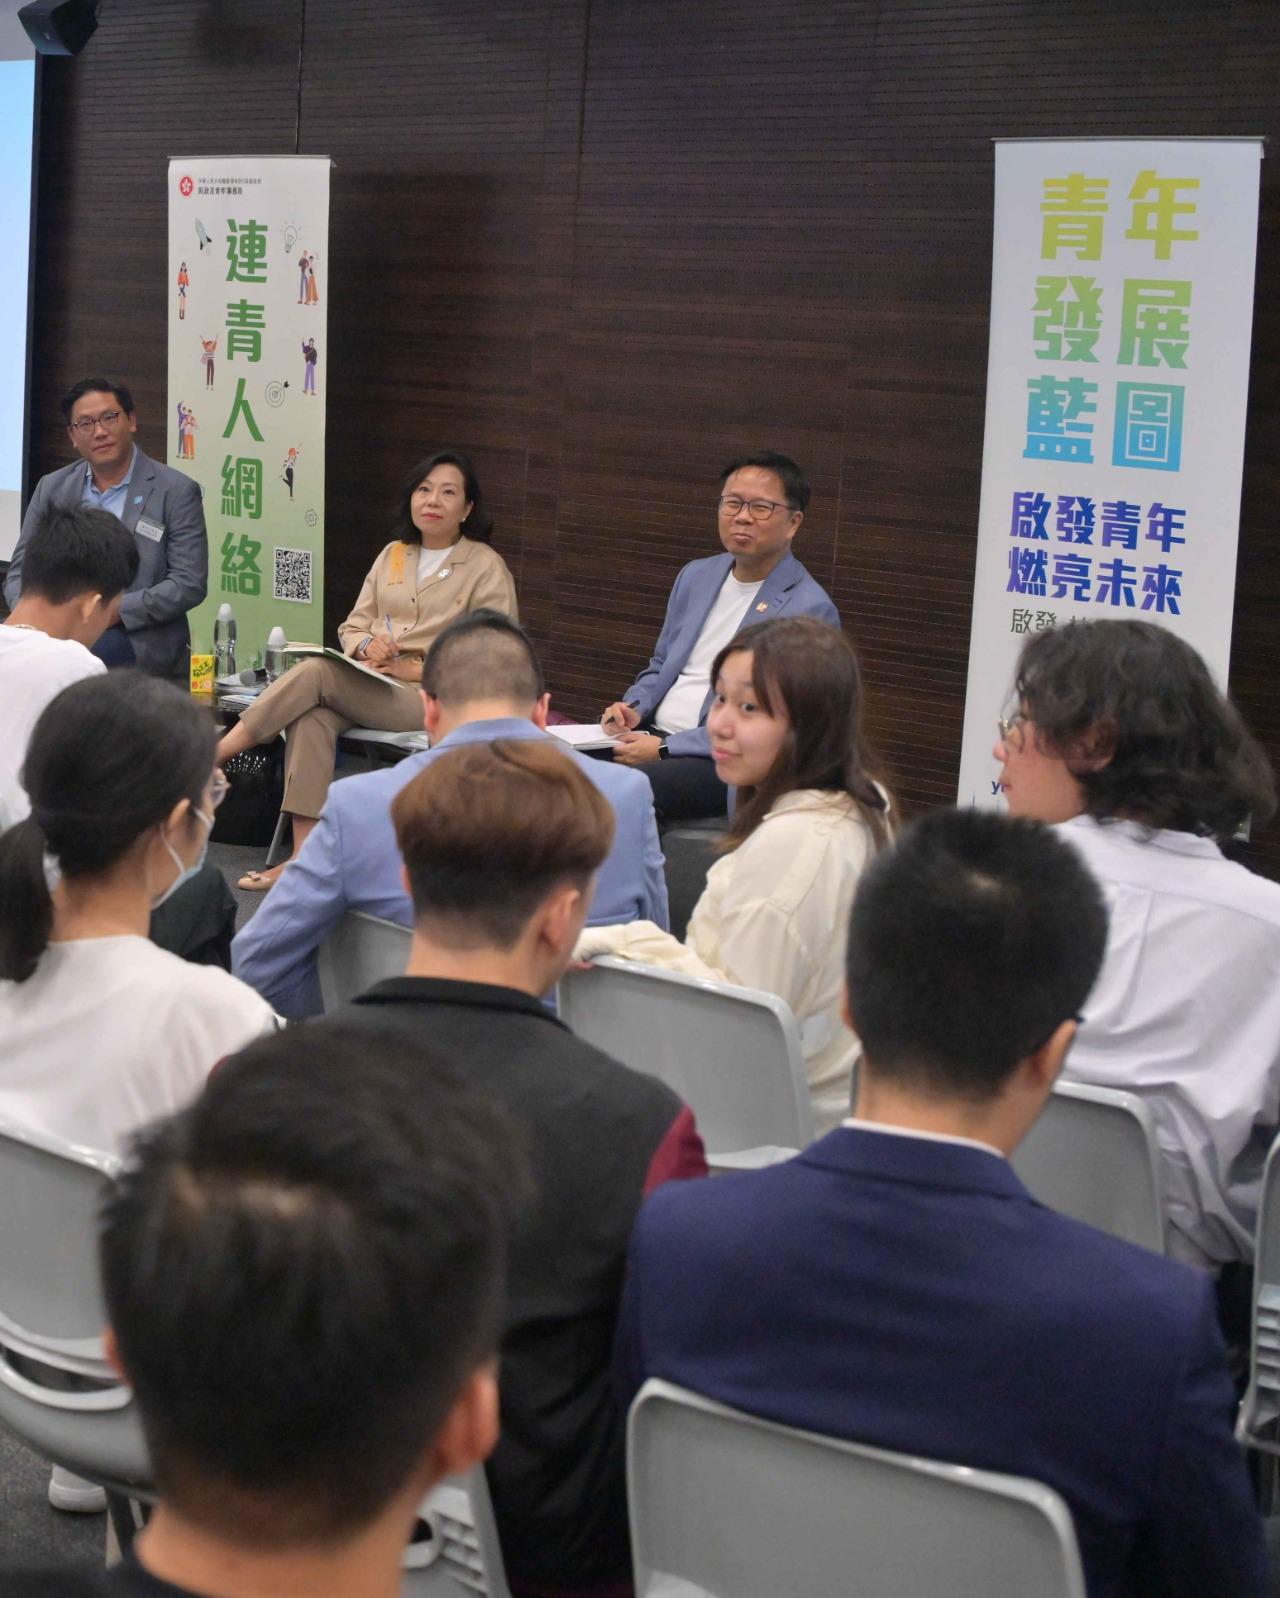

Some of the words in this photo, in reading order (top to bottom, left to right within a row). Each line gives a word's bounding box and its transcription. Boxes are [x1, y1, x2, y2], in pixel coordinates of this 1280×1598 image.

[1040, 169, 1200, 261] 青年
[1031, 275, 1192, 369] 發展
[221, 218, 268, 597] 連青人網絡
[1022, 374, 1185, 472] 藍圖
[1009, 491, 1187, 553] 啟發青年
[1006, 546, 1183, 615] 燃亮未來
